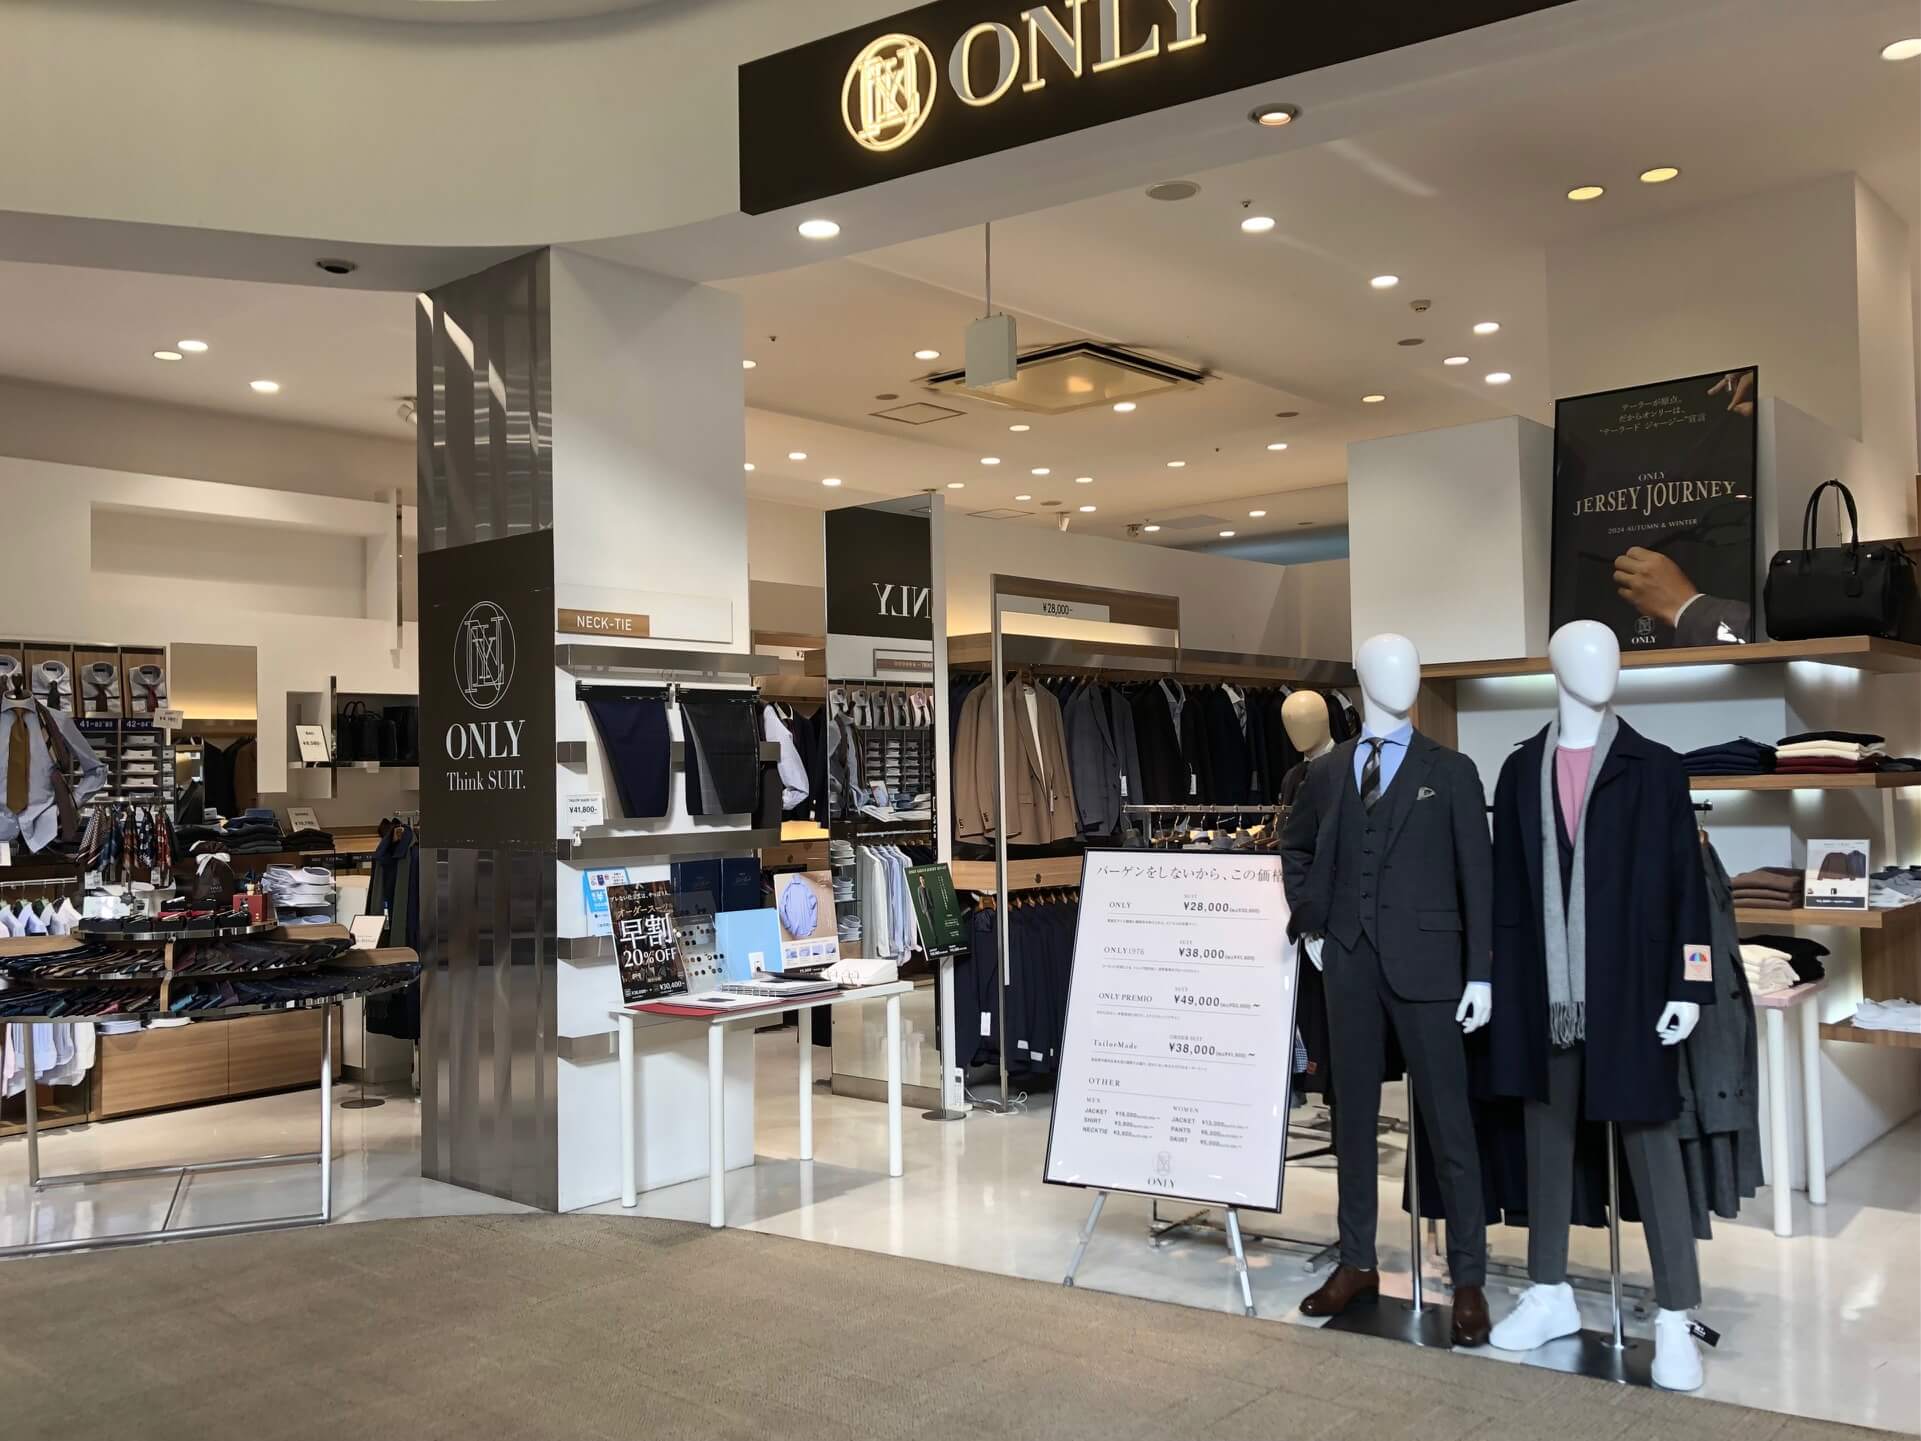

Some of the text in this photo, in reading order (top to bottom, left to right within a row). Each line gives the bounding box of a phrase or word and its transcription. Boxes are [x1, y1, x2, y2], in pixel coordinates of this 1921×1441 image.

[948, 0, 1207, 107] ONLY
[1638, 471, 1665, 482] ONLY
[1572, 480, 1736, 516] JERSEY JOURNEY
[1627, 523, 1659, 533] AUTUMN
[1668, 518, 1698, 528] WINTER
[577, 615, 632, 631] NECK-TIE
[1631, 635, 1656, 644] ONLY
[446, 720, 525, 760] ONLY
[446, 769, 526, 791] Think SUIT.
[1109, 901, 1132, 909] ONLY
[1184, 901, 1229, 912] ¥28,000
[620, 913, 673, 949] 早割
[1179, 947, 1225, 960] ¥38,000
[1098, 992, 1119, 1000] ONLY
[1121, 993, 1153, 1003] PREMIO
[1174, 995, 1220, 1007] ¥49,000
[1169, 1042, 1216, 1056] ¥38,000
[1088, 1077, 1121, 1087] OTHER
[1171, 1117, 1195, 1125] JACKET
[1082, 1127, 1108, 1135] NECKTIE
[1147, 1177, 1176, 1189] ONLY
